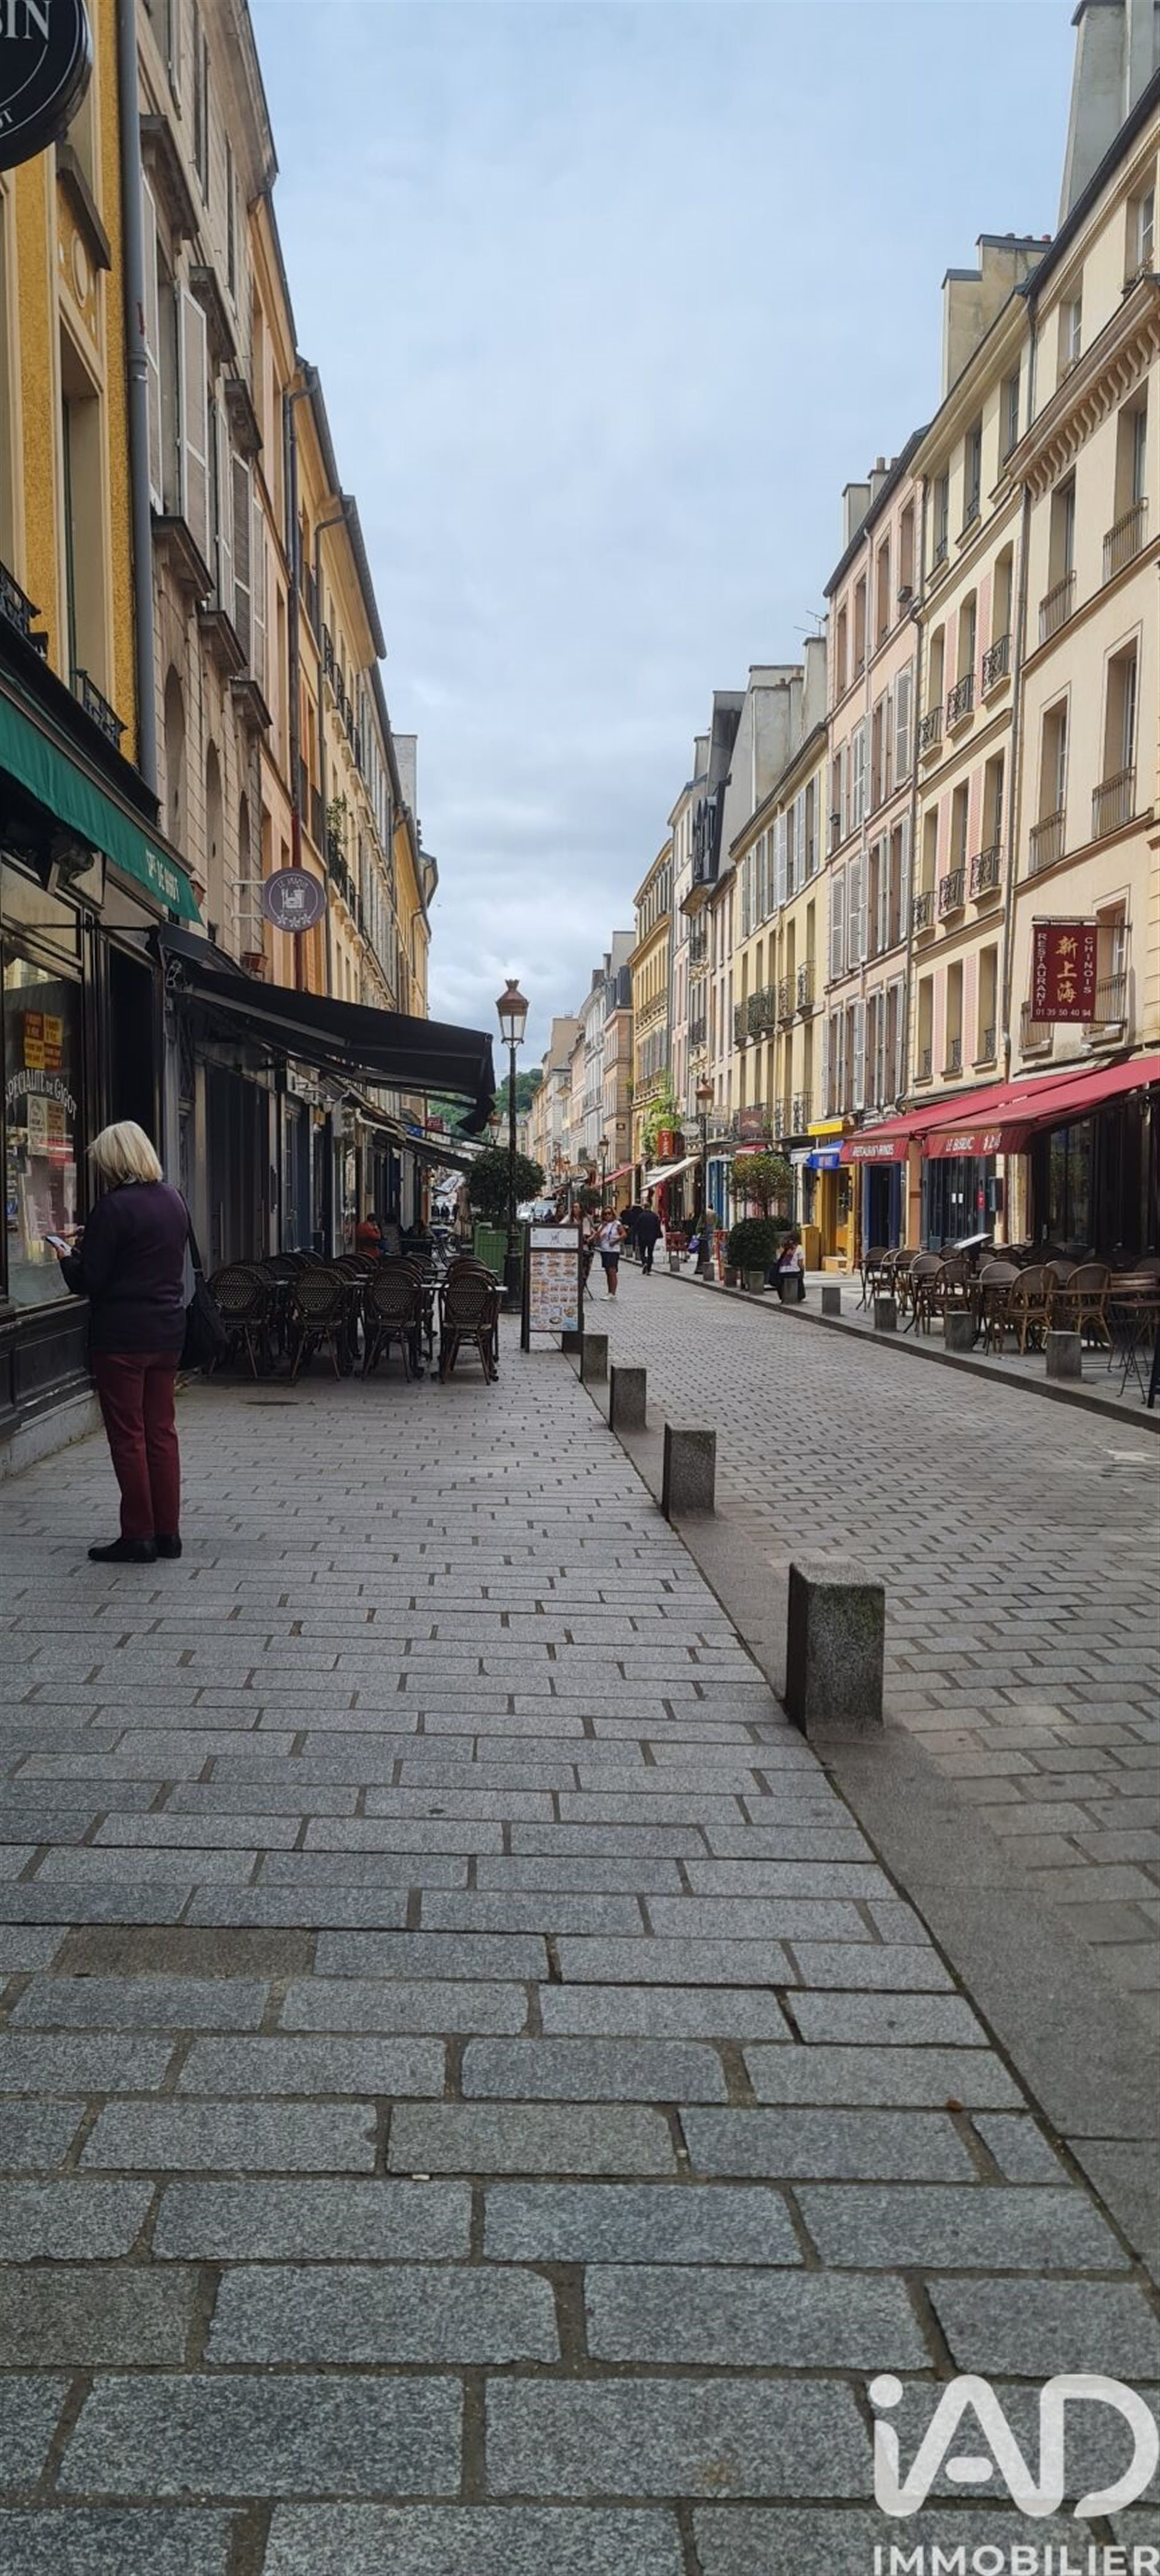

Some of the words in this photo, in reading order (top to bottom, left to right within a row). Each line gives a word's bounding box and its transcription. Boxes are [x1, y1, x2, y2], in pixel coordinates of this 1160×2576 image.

[0, 0, 52, 40] IN
[1037, 933, 1047, 1006] RESTAURANT
[1055, 935, 1078, 1003] 新上海
[1083, 937, 1094, 994] CHINOIS
[54, 1078, 77, 1121] GIGOT
